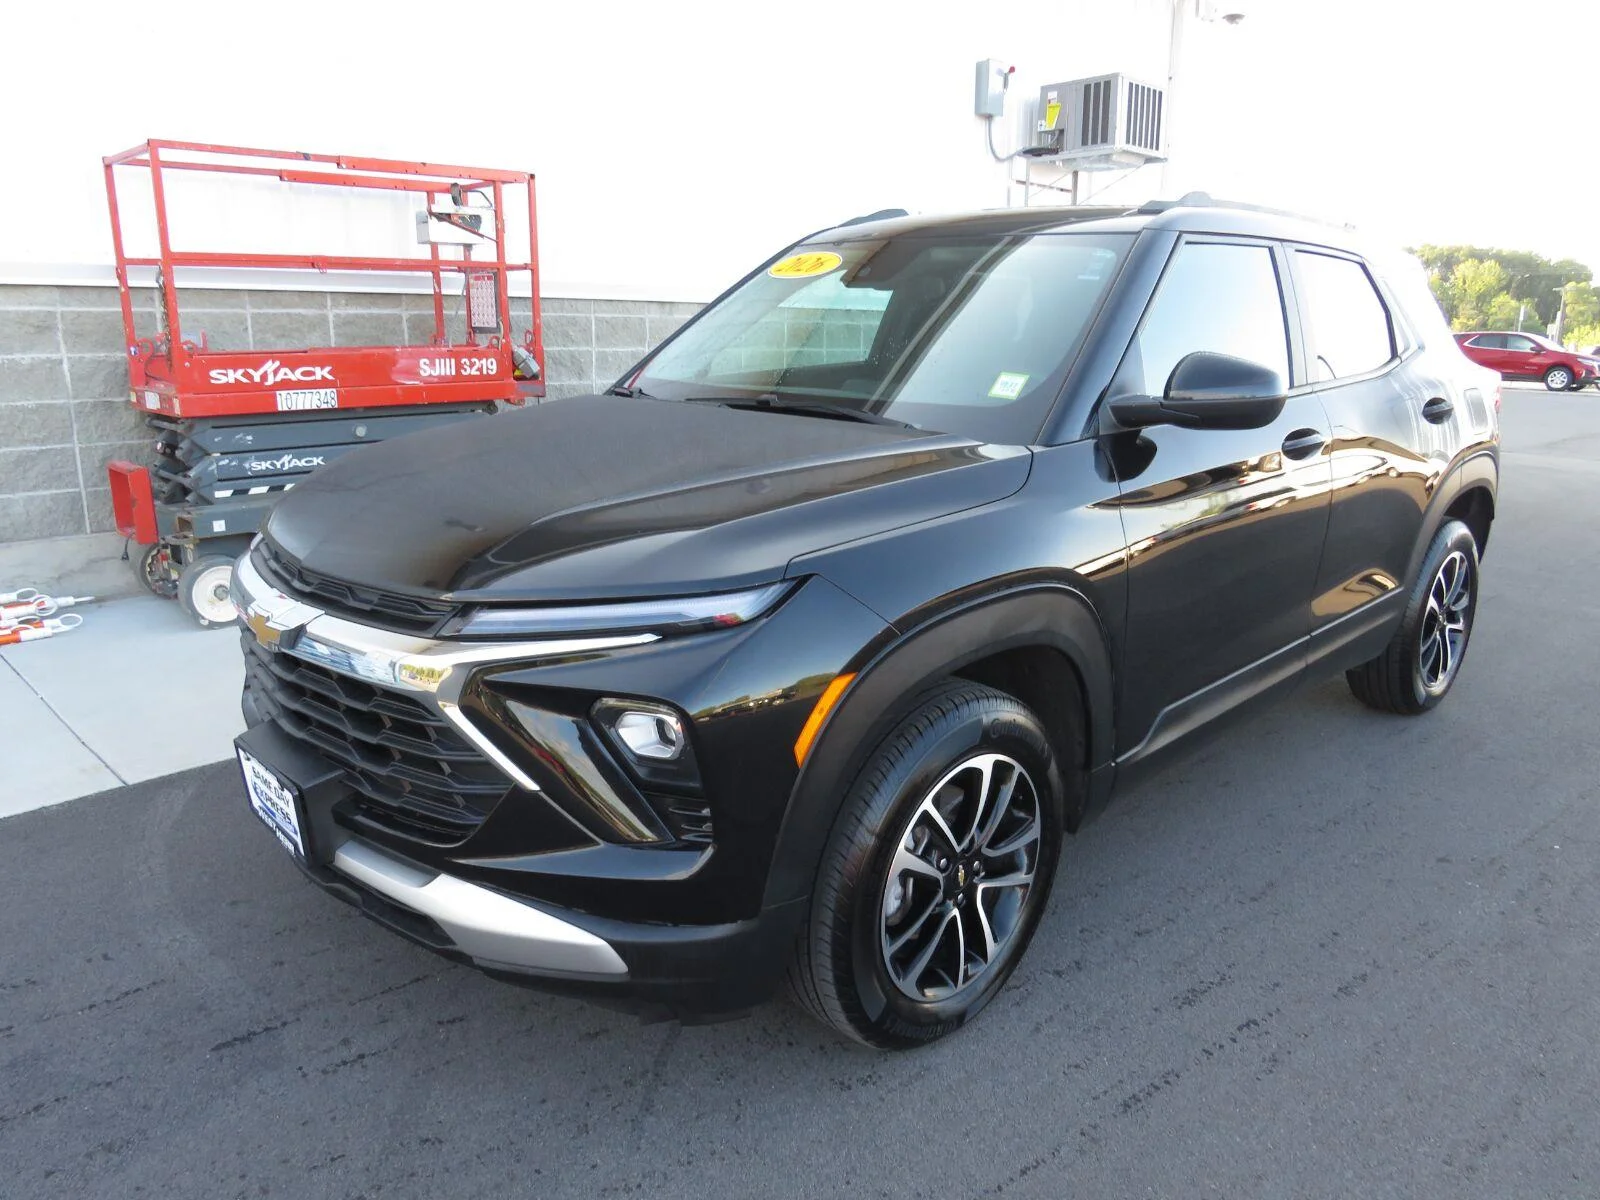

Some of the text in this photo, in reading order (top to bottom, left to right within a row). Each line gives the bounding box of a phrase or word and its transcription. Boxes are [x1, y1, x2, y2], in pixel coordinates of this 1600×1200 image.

[208, 358, 336, 386] SKYJACK
[460, 357, 498, 376] 3219
[277, 390, 338, 411] 10777348
[250, 453, 326, 471] SKYJACK
